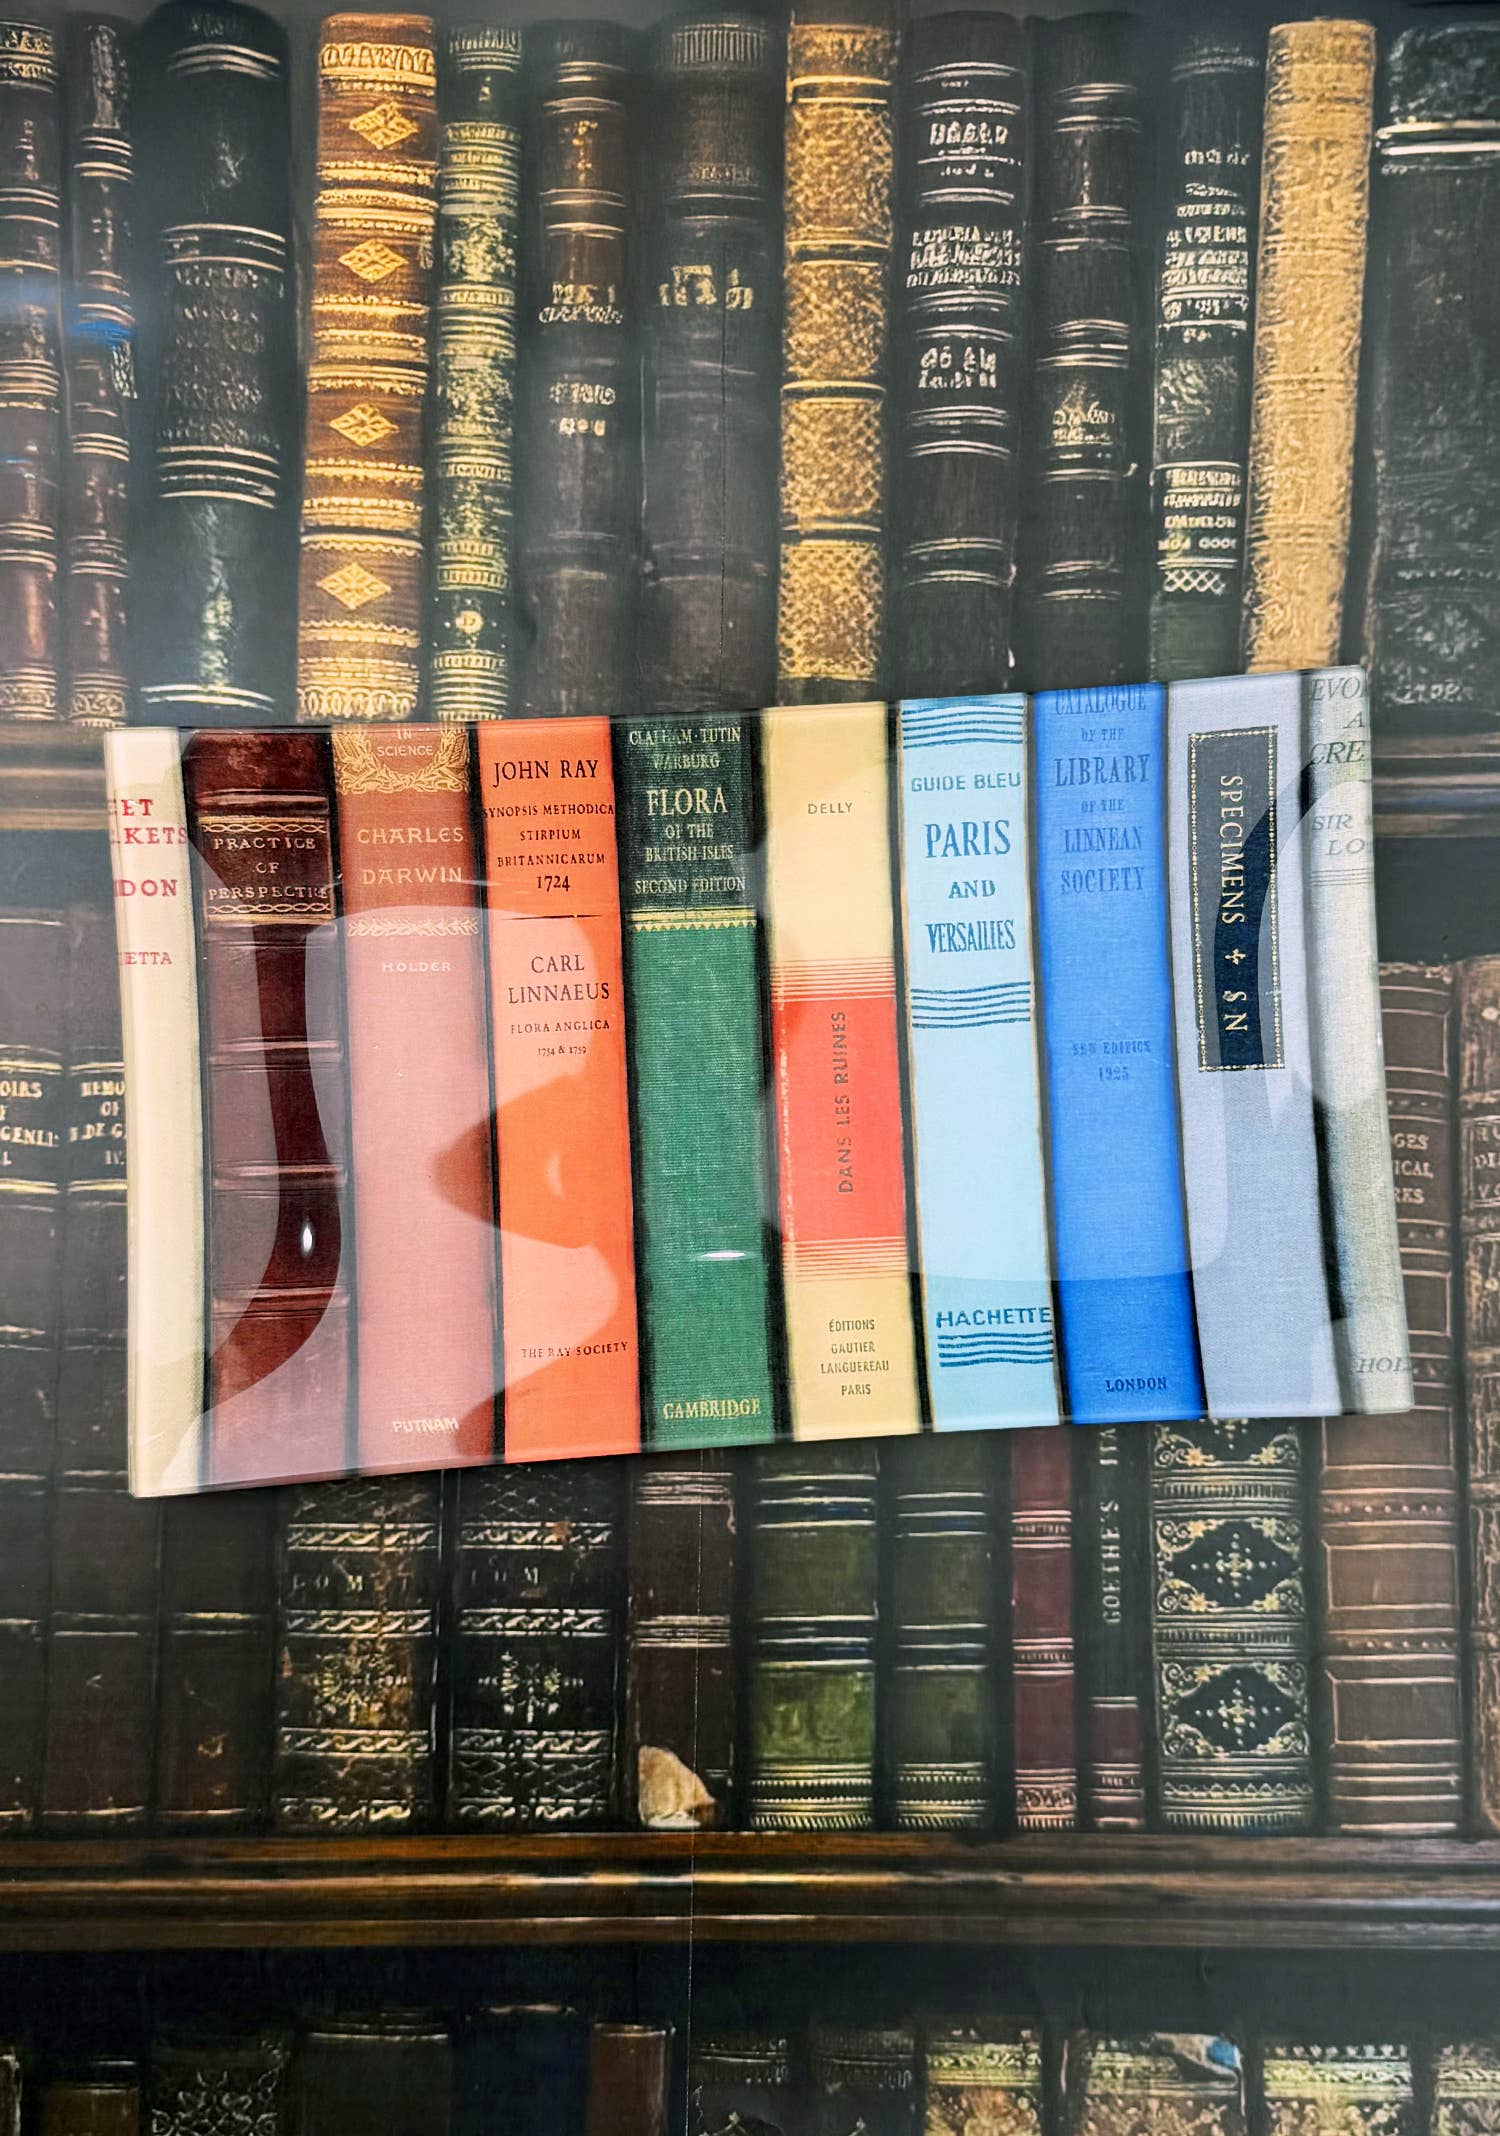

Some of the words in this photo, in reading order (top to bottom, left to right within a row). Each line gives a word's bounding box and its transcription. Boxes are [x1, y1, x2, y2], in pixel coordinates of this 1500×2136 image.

[1055, 684, 1146, 715] CATALOGUE
[700, 727, 741, 743] TUTIN
[1101, 727, 1124, 741] THE
[377, 745, 434, 757] SCIENCE
[493, 760, 550, 787] JOHN
[560, 758, 599, 779] RAY
[1054, 753, 1150, 787] LIBRARY
[910, 774, 966, 792] GUIDE
[973, 772, 1022, 790] BLEU
[120, 798, 154, 817] ET
[483, 805, 538, 819] SYNOPSIS
[543, 803, 615, 816] METHODICA
[645, 787, 728, 817] FLORA
[807, 801, 853, 815] DELLY
[1081, 800, 1096, 813] OF
[1101, 798, 1124, 812] THE
[687, 822, 714, 839] THE
[1312, 813, 1354, 831] SIR
[112, 826, 187, 845] KETS
[356, 826, 465, 845] CHARLES
[519, 828, 581, 841] STIRPIUM
[923, 819, 1012, 859] PARIS
[1063, 826, 1143, 853] LINNEAN
[214, 837, 316, 851] PRACTICE
[645, 846, 697, 862] BRITISH
[702, 844, 734, 860] ISLES
[1219, 775, 1246, 925] SPECIMENS
[255, 862, 280, 874] OF
[497, 853, 605, 868] BRITANNICARUM
[360, 866, 463, 885] DARWIN
[536, 875, 571, 892] 1724
[1060, 866, 1145, 896] SOCIETY
[635, 878, 687, 895] SECOND
[692, 876, 746, 893] EDITION
[948, 879, 996, 899] AND
[925, 919, 1016, 954] VERSAILLES
[381, 960, 452, 973] HOLDER
[531, 954, 585, 973] CARL
[508, 982, 610, 1004] LINNAEUS
[511, 1023, 550, 1035] FLORA
[555, 1019, 610, 1032] ANGLICA
[831, 1011, 849, 1084] RUINES
[835, 1095, 850, 1126] LES
[838, 1137, 854, 1193] DANS
[828, 1318, 875, 1332] ÉDITIONS
[936, 1305, 1052, 1329] HACHETTE
[521, 1347, 543, 1358] THE
[549, 1347, 571, 1358] RAY
[576, 1341, 629, 1356] SOCIETY
[831, 1341, 876, 1354] GAUTIER
[820, 1360, 889, 1374] LANGUEREAU
[841, 1383, 872, 1396] PARIS
[1105, 1376, 1168, 1393] LONDON
[662, 1397, 762, 1421] CAMBRIDGE
[391, 1416, 460, 1434] PUTNAM
